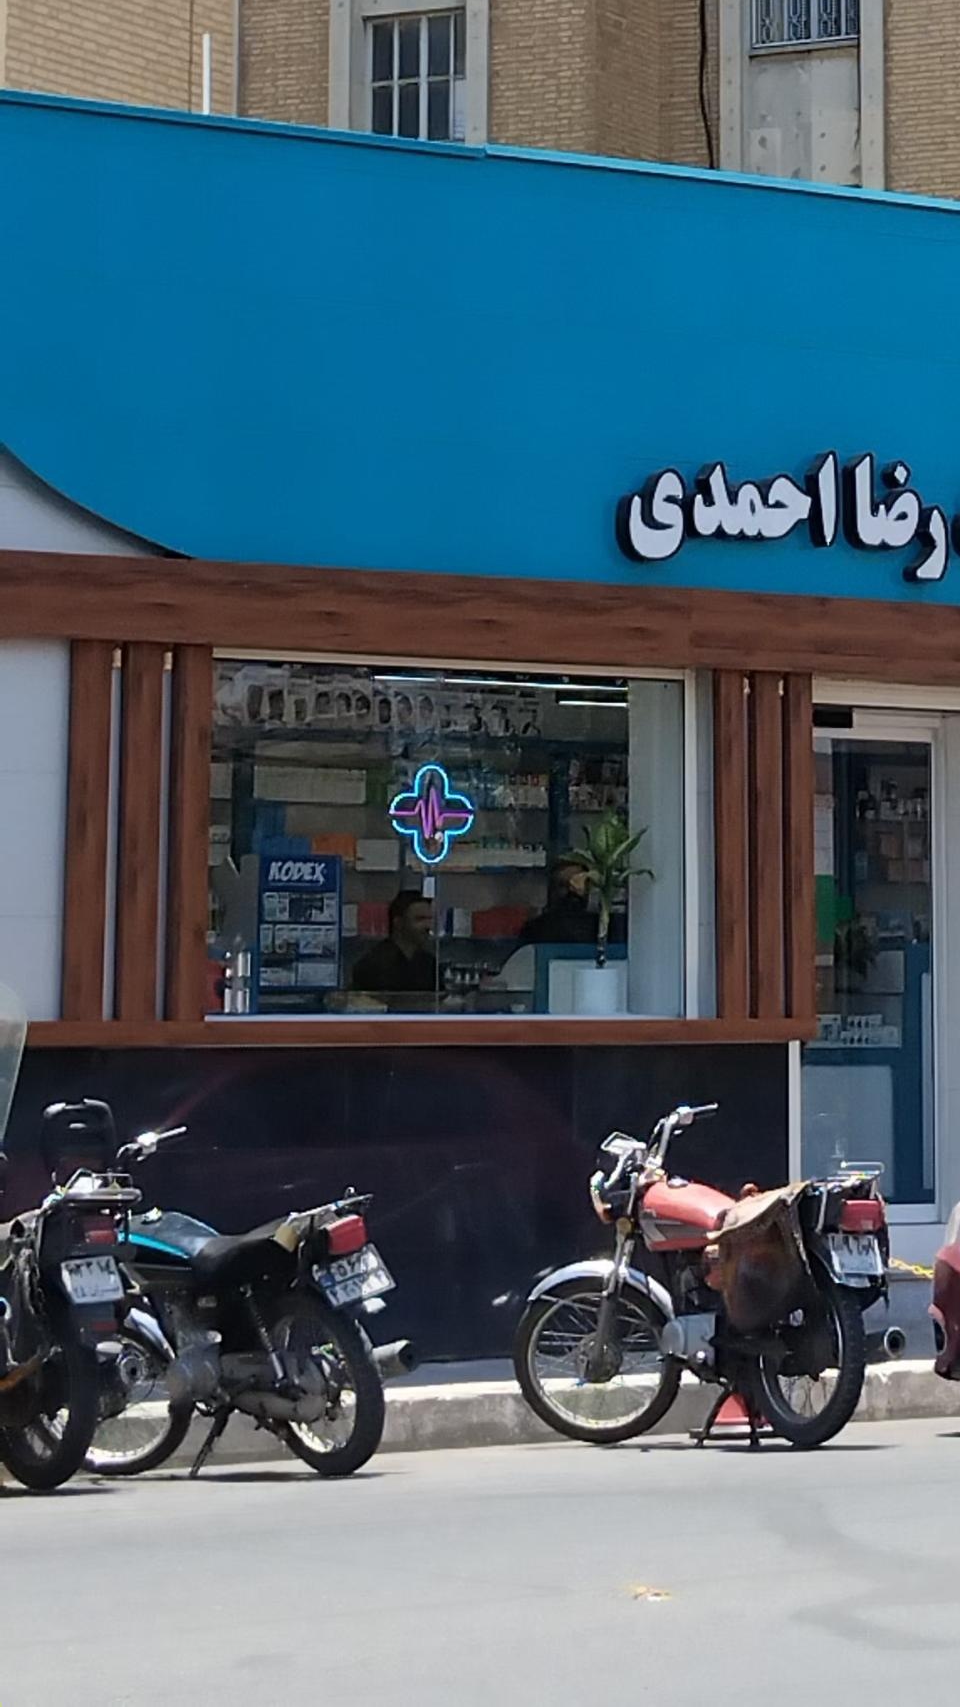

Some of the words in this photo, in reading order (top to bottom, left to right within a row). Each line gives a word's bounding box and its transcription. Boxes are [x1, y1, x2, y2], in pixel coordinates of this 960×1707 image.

[617, 450, 838, 563] احمدی
[843, 452, 948, 581] رضا
[268, 859, 326, 885] KODEX
